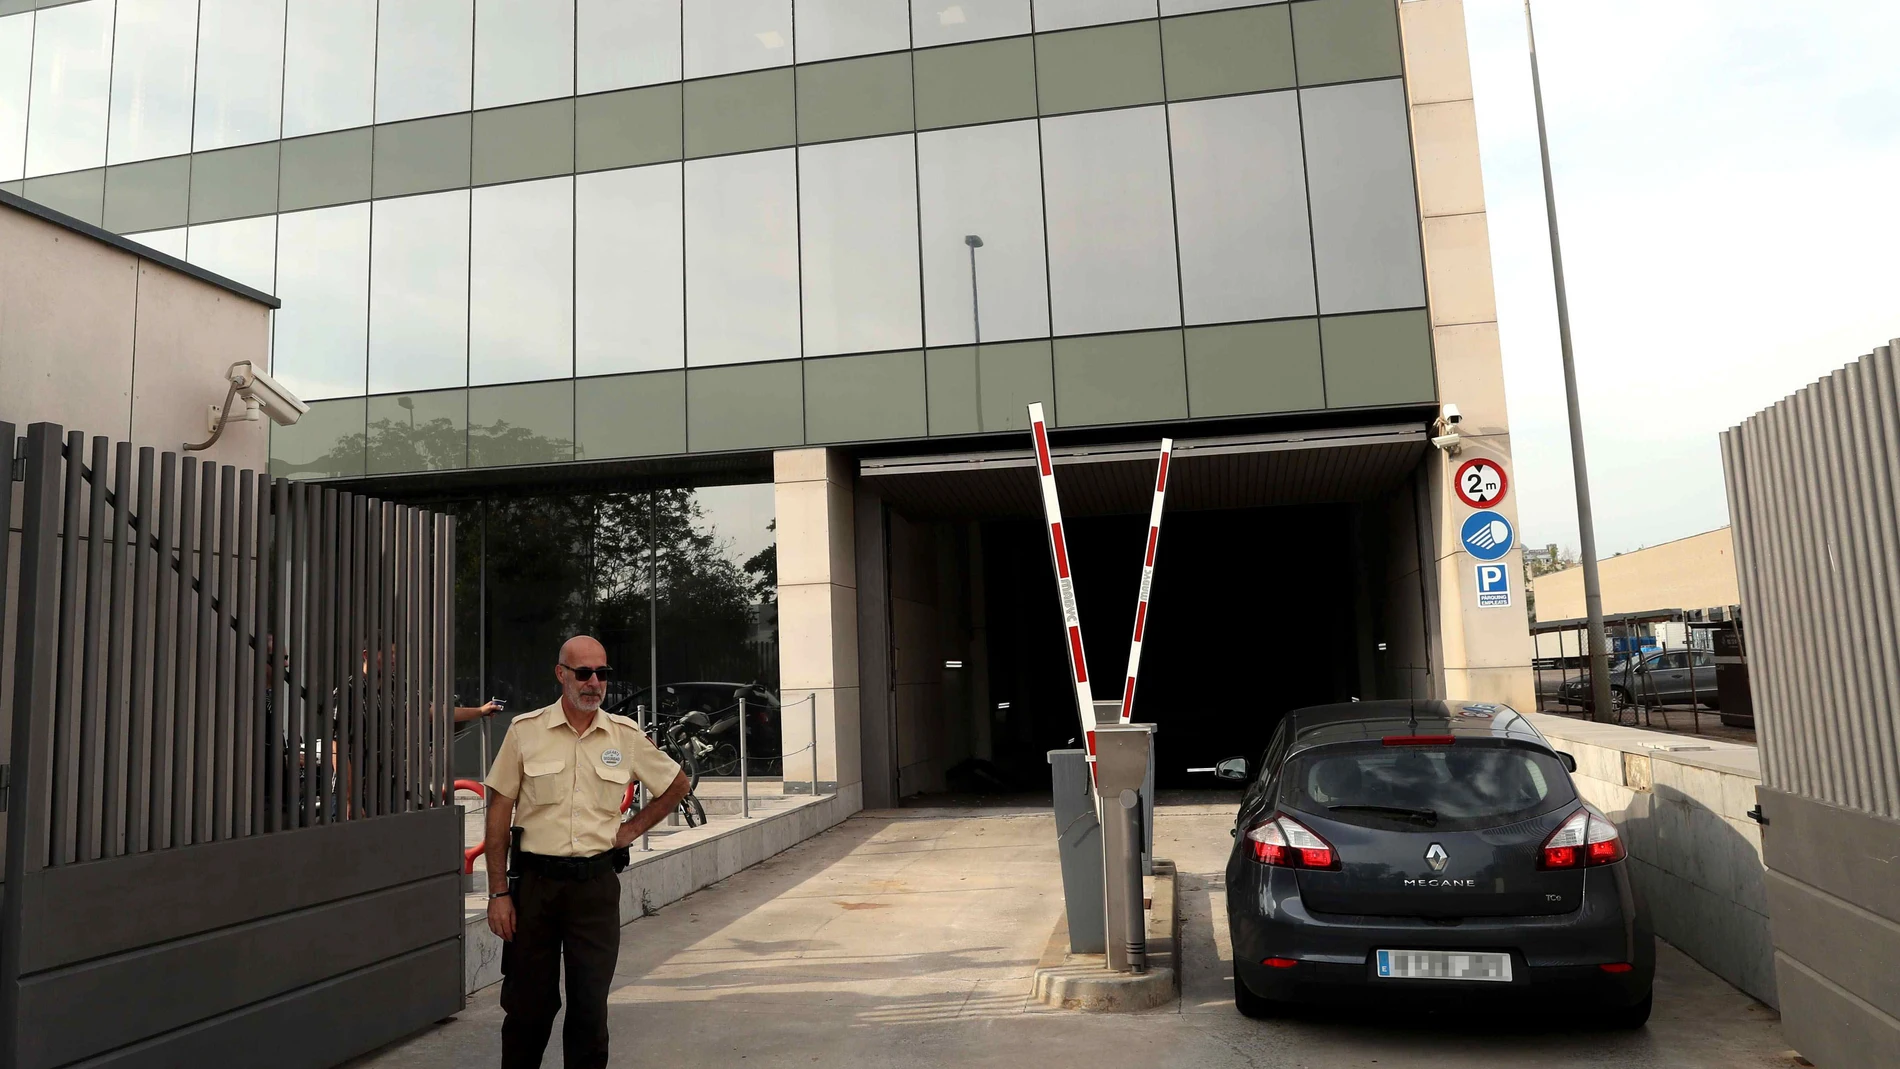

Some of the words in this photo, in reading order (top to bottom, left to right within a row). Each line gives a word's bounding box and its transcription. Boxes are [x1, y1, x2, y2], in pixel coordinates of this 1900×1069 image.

[1467, 474, 1483, 493] 2
[1486, 482, 1497, 490] m
[1481, 566, 1502, 591] P
[1404, 879, 1475, 887] MEGANE
